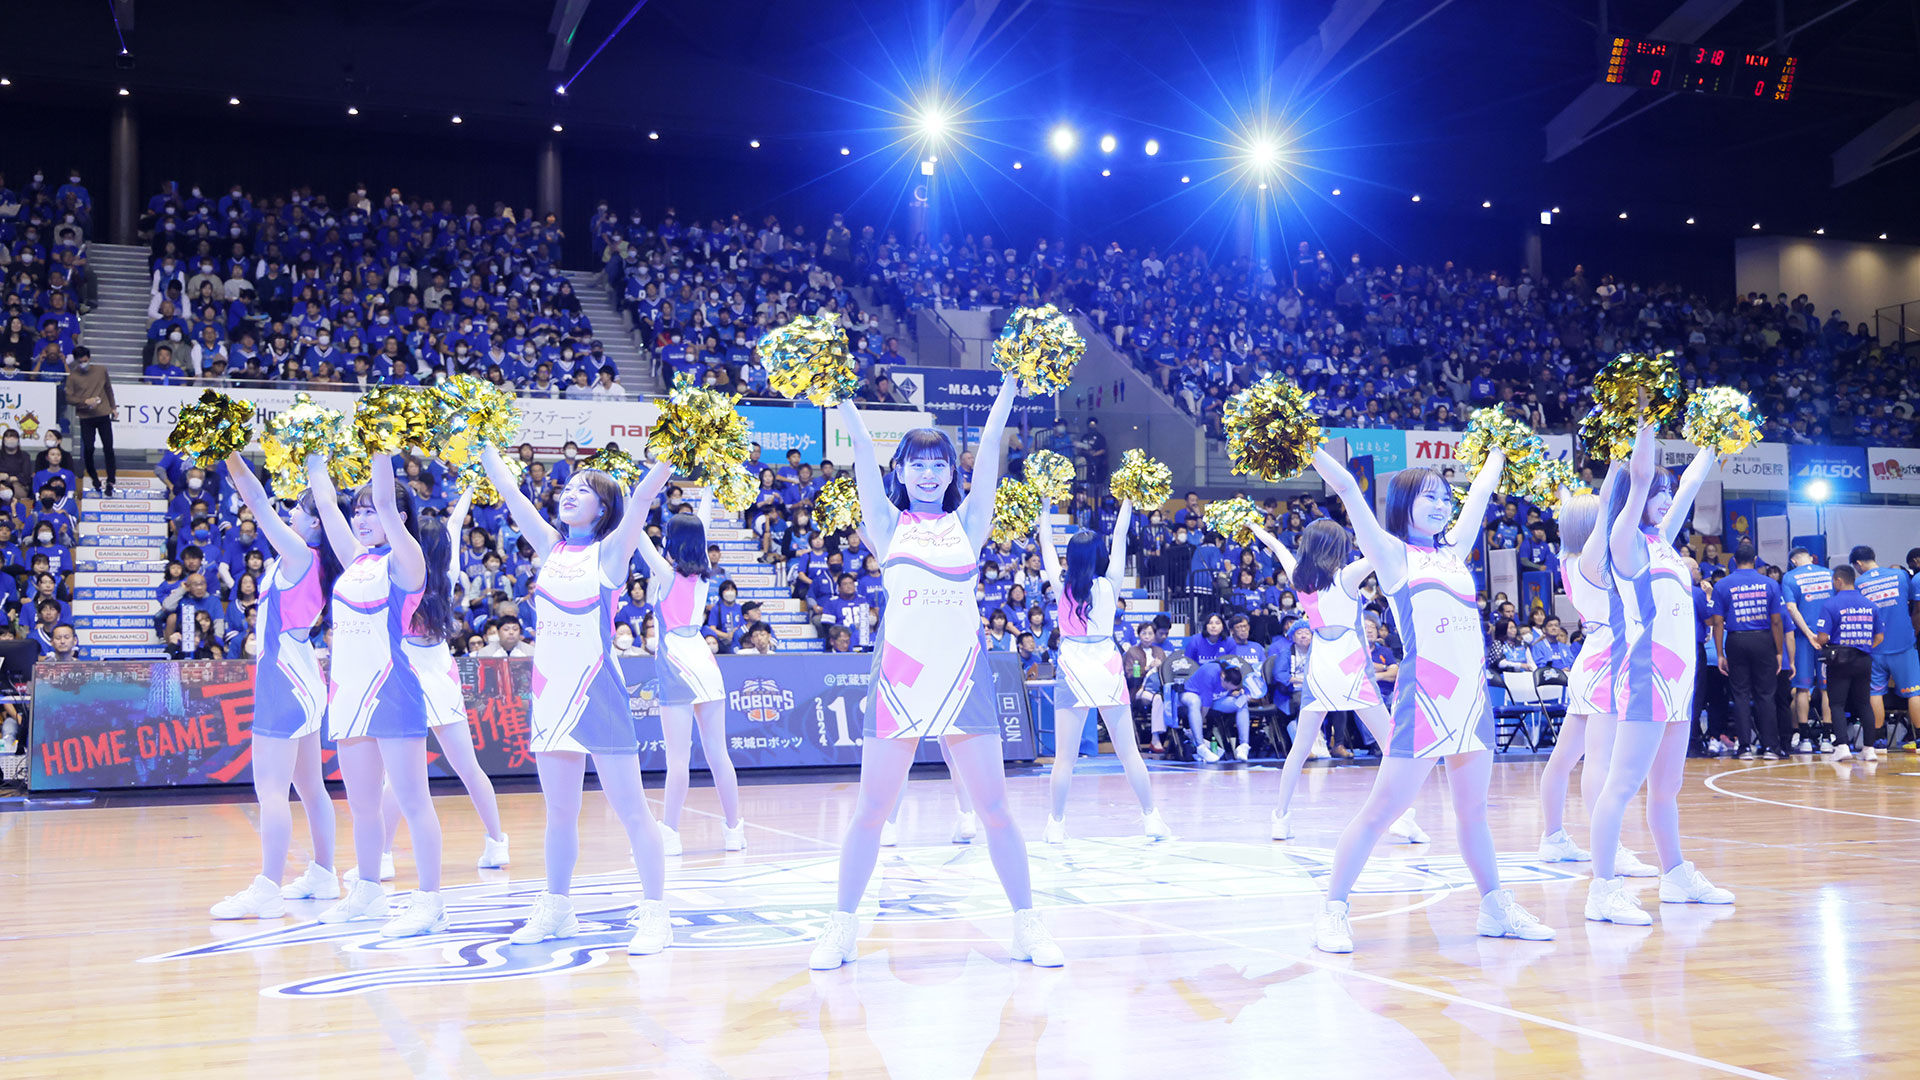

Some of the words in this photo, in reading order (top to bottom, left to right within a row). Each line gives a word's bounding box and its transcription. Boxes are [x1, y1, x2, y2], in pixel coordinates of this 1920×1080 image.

[1696, 48, 1725, 66] 3:18
[1651, 69, 1661, 85] 0
[1754, 80, 1765, 96] 0
[513, 428, 574, 443] アコート
[1732, 463, 1784, 476] よしの医院
[1810, 464, 1862, 479] ALSOK
[729, 689, 795, 712] ROBOTS
[814, 697, 828, 747] 2024
[827, 696, 867, 747] 1.
[1004, 716, 1022, 743] SUN
[41, 729, 132, 777] HOME
[136, 714, 221, 759] GAME
[730, 736, 803, 750] 茨城ロボッツ
